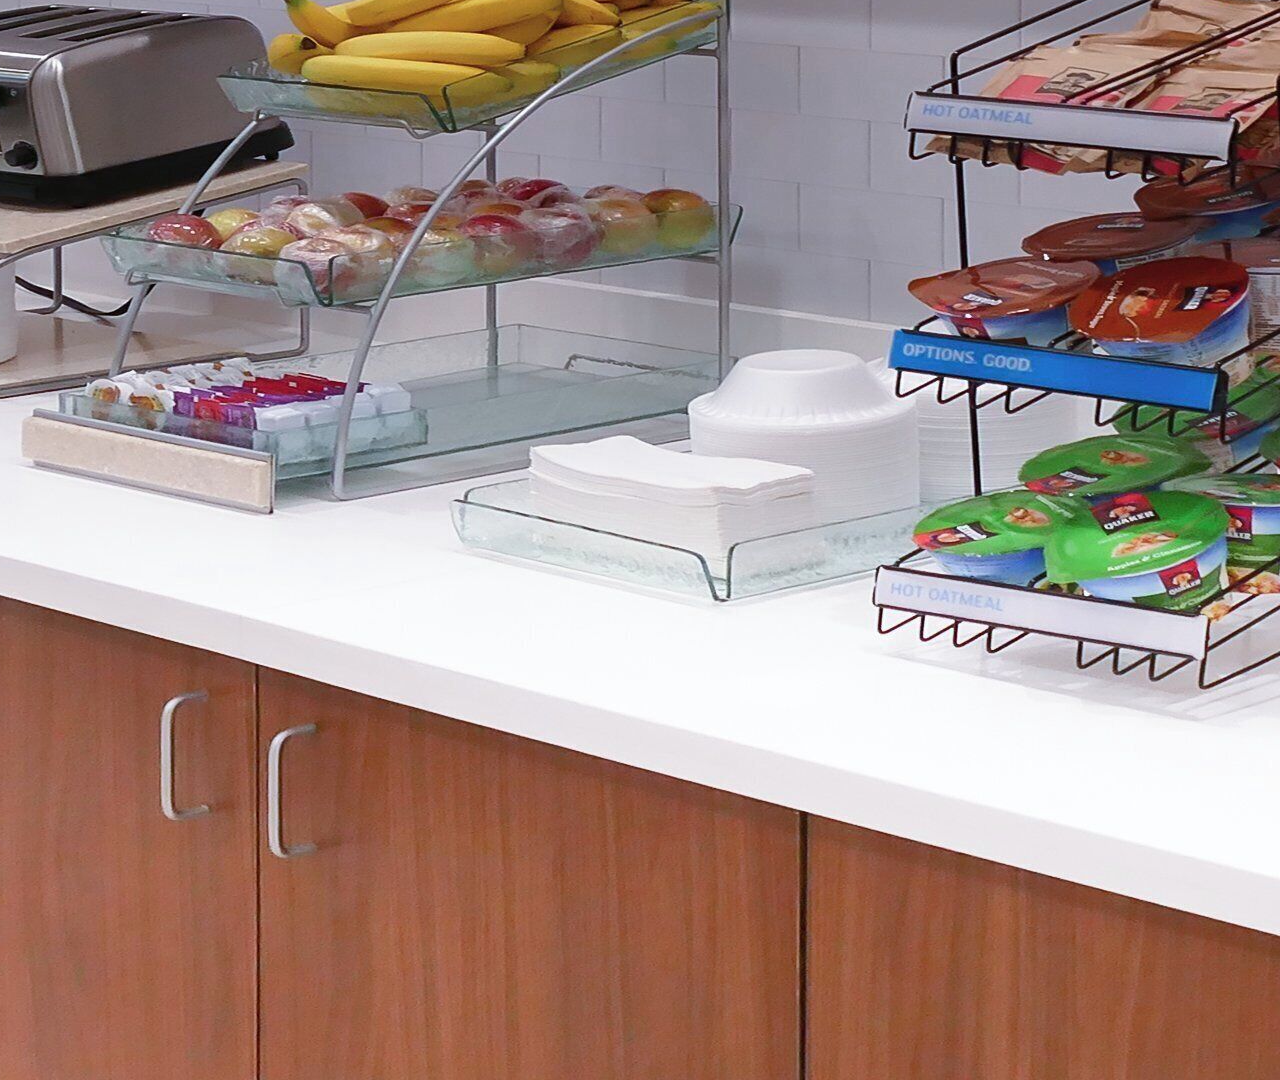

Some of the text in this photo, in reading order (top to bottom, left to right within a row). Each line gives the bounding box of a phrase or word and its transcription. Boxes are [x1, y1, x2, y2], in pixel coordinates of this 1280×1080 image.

[922, 104, 1034, 125] HOT OATMEAL
[1103, 510, 1155, 530] QUAKER
[890, 583, 1004, 612] HOT OATMEAL
